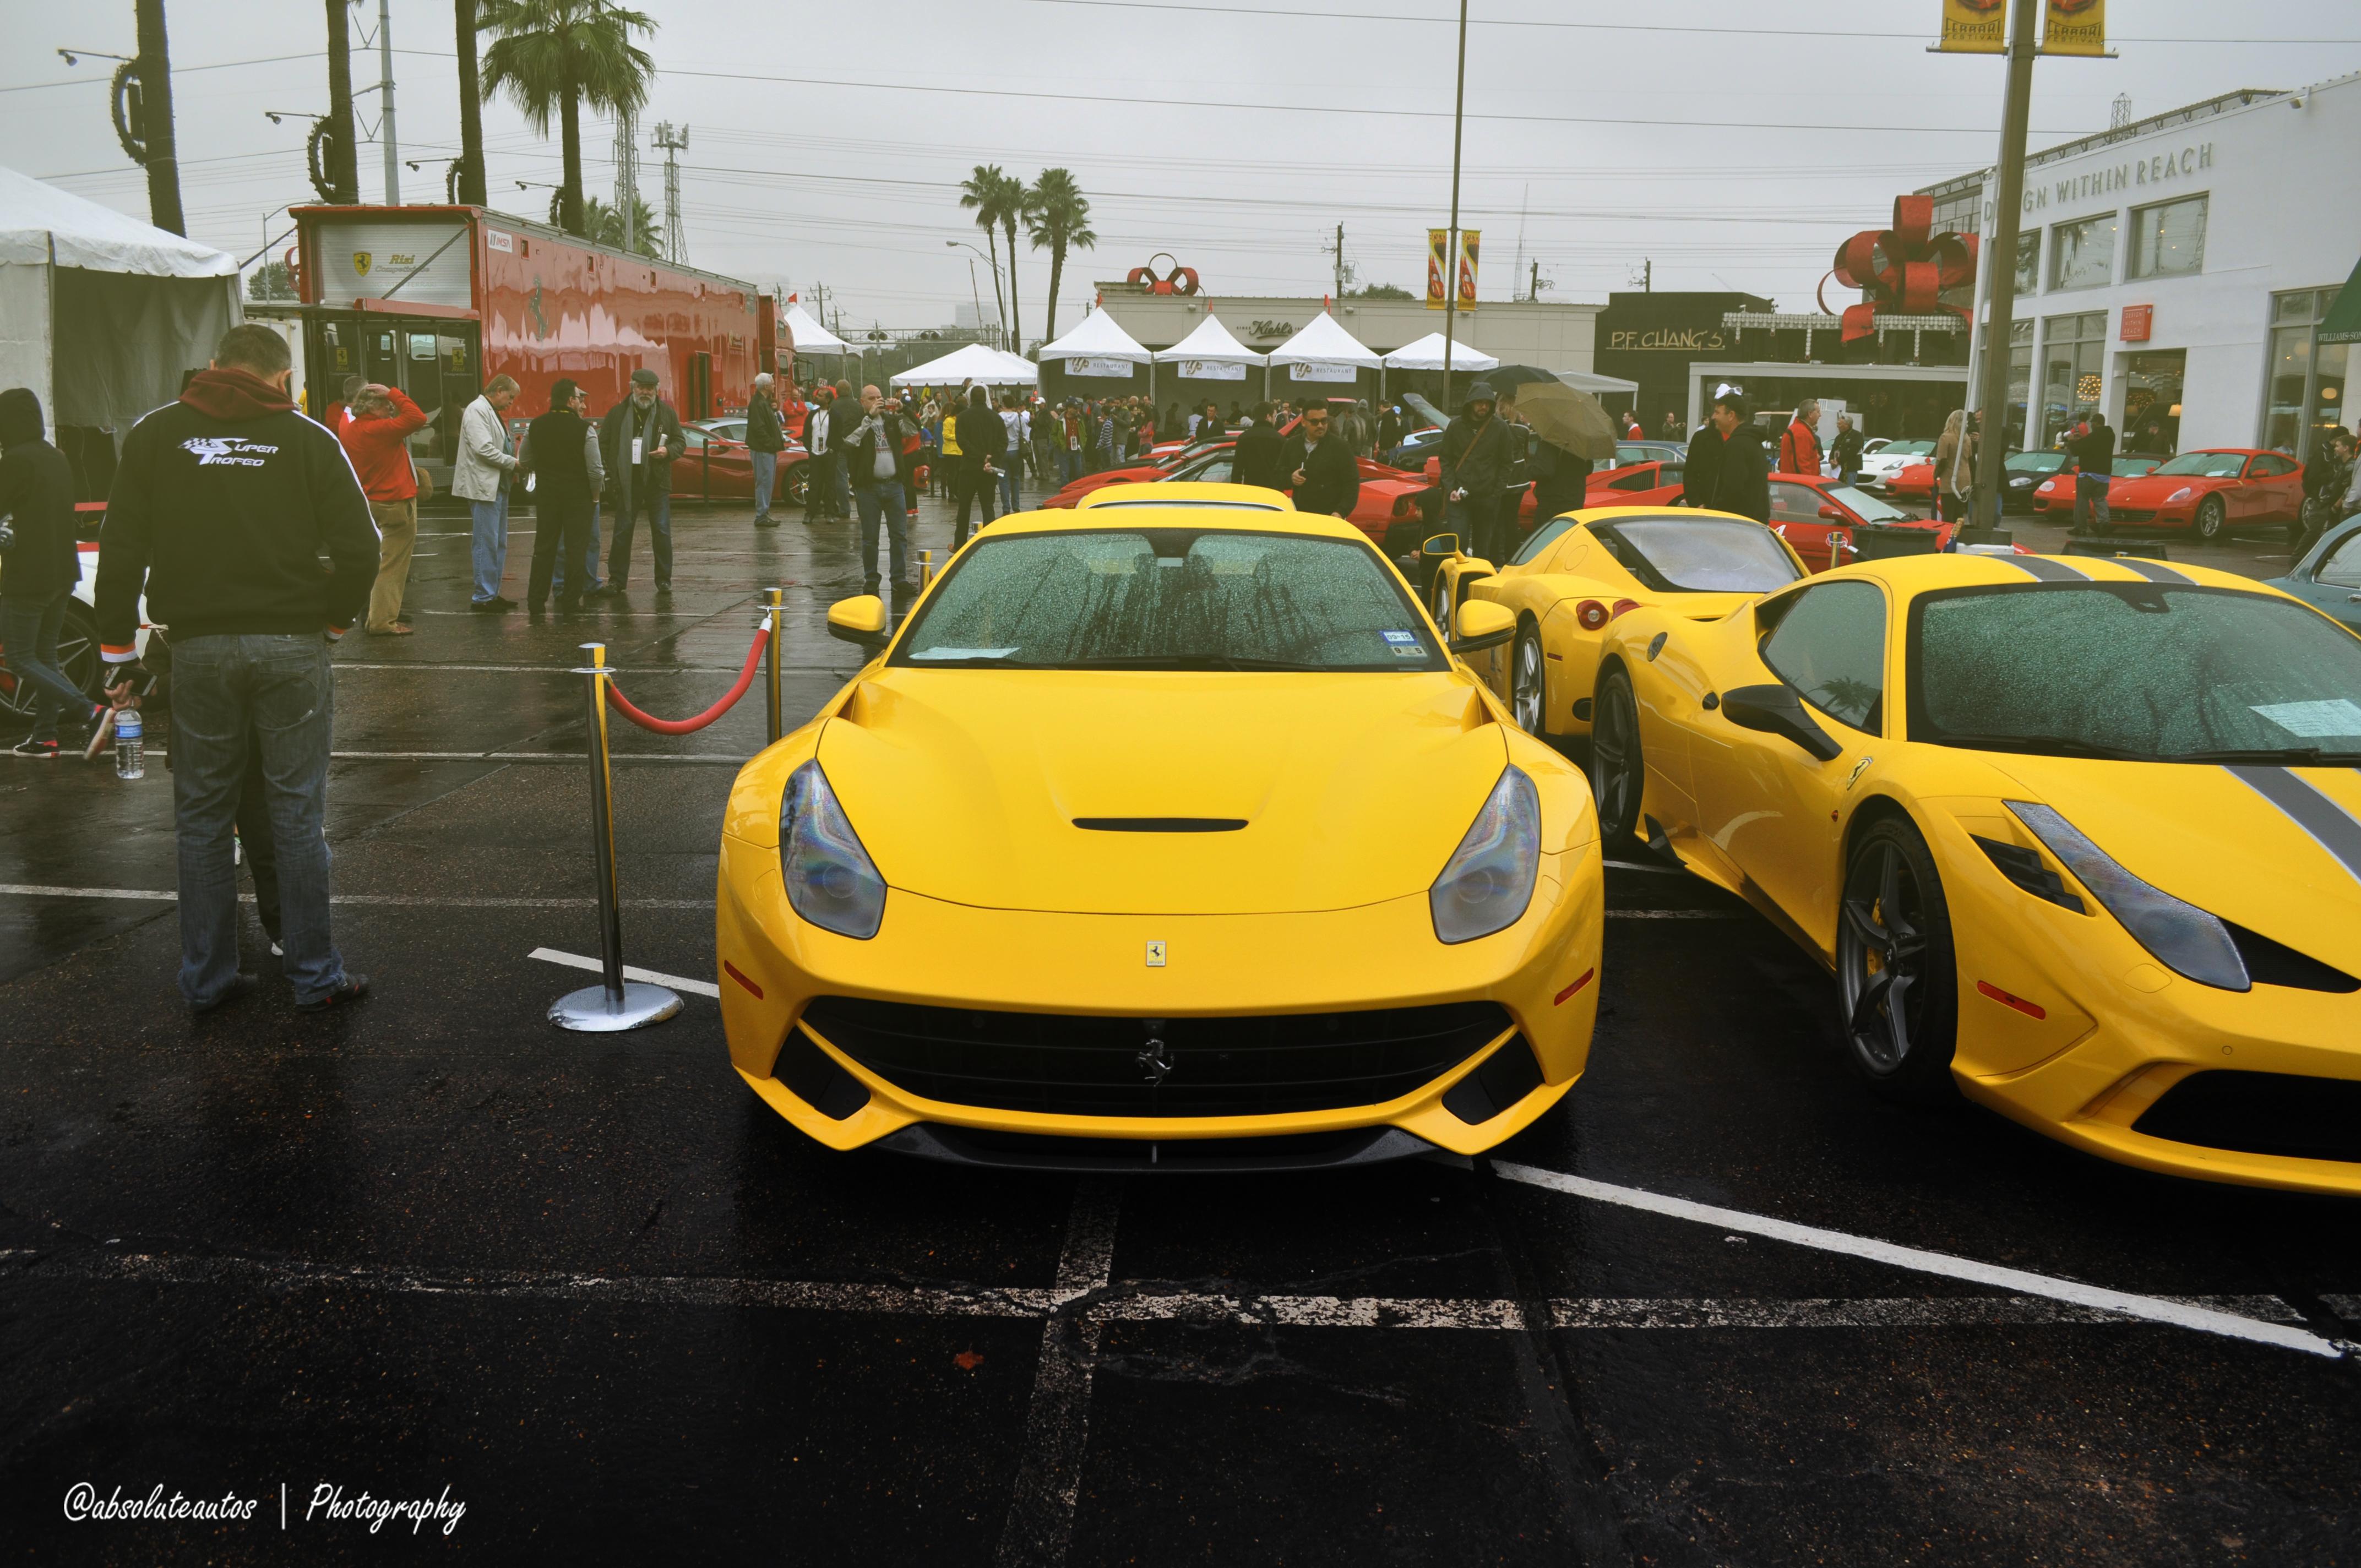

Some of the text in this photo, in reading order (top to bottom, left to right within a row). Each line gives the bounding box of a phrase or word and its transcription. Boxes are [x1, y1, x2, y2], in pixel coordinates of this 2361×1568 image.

[1945, 18, 2000, 34] FERRARI
[2048, 19, 2102, 36] FERRARI
[2057, 164, 2128, 204] WITHIN
[2136, 141, 2212, 185] REACH
[1249, 320, 1293, 335] Kiehl's
[1611, 331, 1638, 350] P.F.
[190, 438, 279, 455] SUPER
[199, 451, 265, 466] TROFEO
